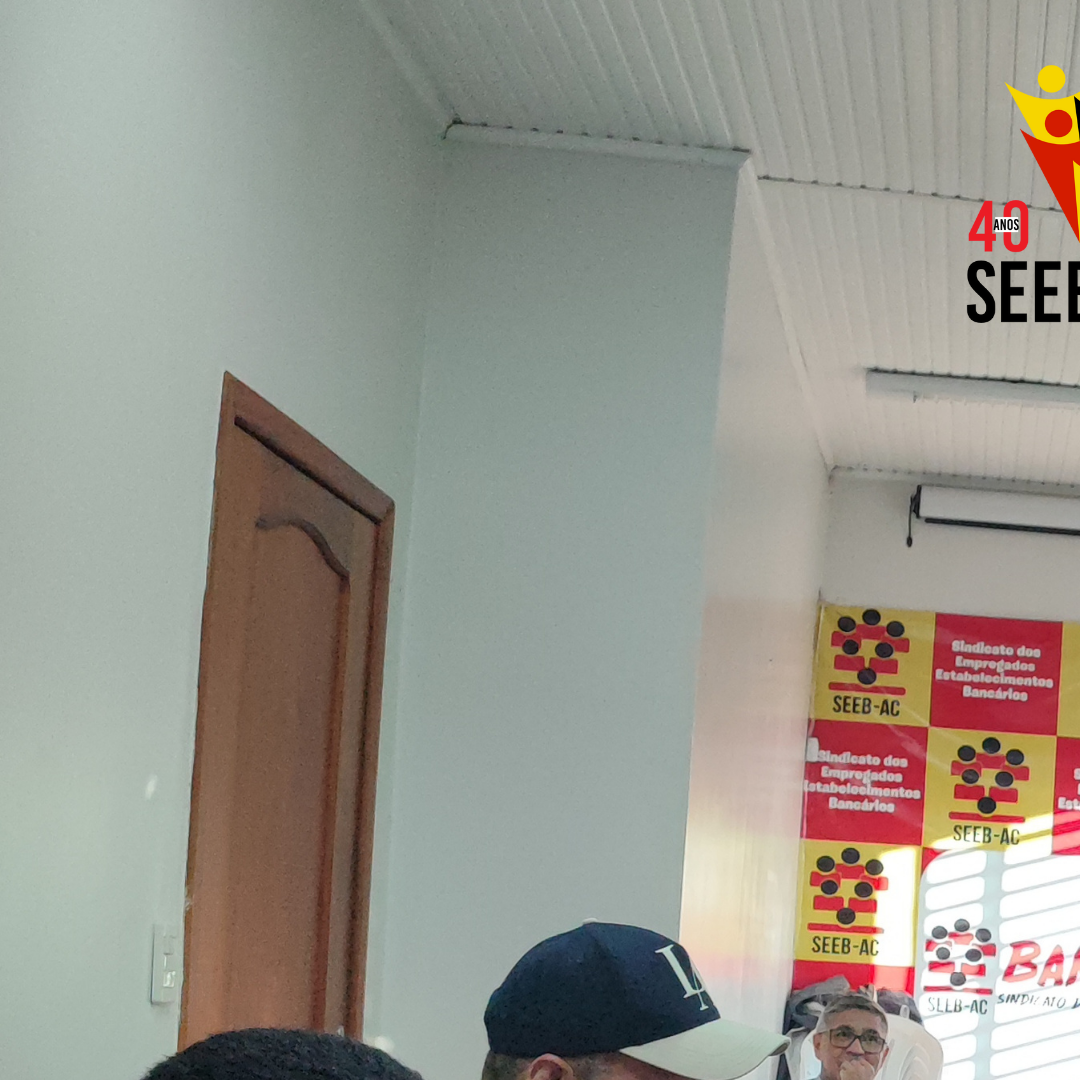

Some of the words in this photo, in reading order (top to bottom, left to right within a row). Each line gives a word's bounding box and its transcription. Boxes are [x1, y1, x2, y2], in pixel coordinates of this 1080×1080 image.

[952, 640, 1014, 655] Sindicato
[1017, 646, 1041, 658] dos
[955, 655, 1036, 673] Empregados
[935, 668, 1054, 688] Estabelecimentos
[963, 685, 1028, 702] Bancários
[832, 695, 900, 717] SEEB-AC
[818, 750, 881, 766] Sindicato
[883, 755, 908, 768] dos
[821, 766, 903, 785] Empregados
[829, 796, 895, 813] Bancários
[953, 824, 1020, 845] SEEB-AC
[811, 935, 879, 957] SEEB-AC
